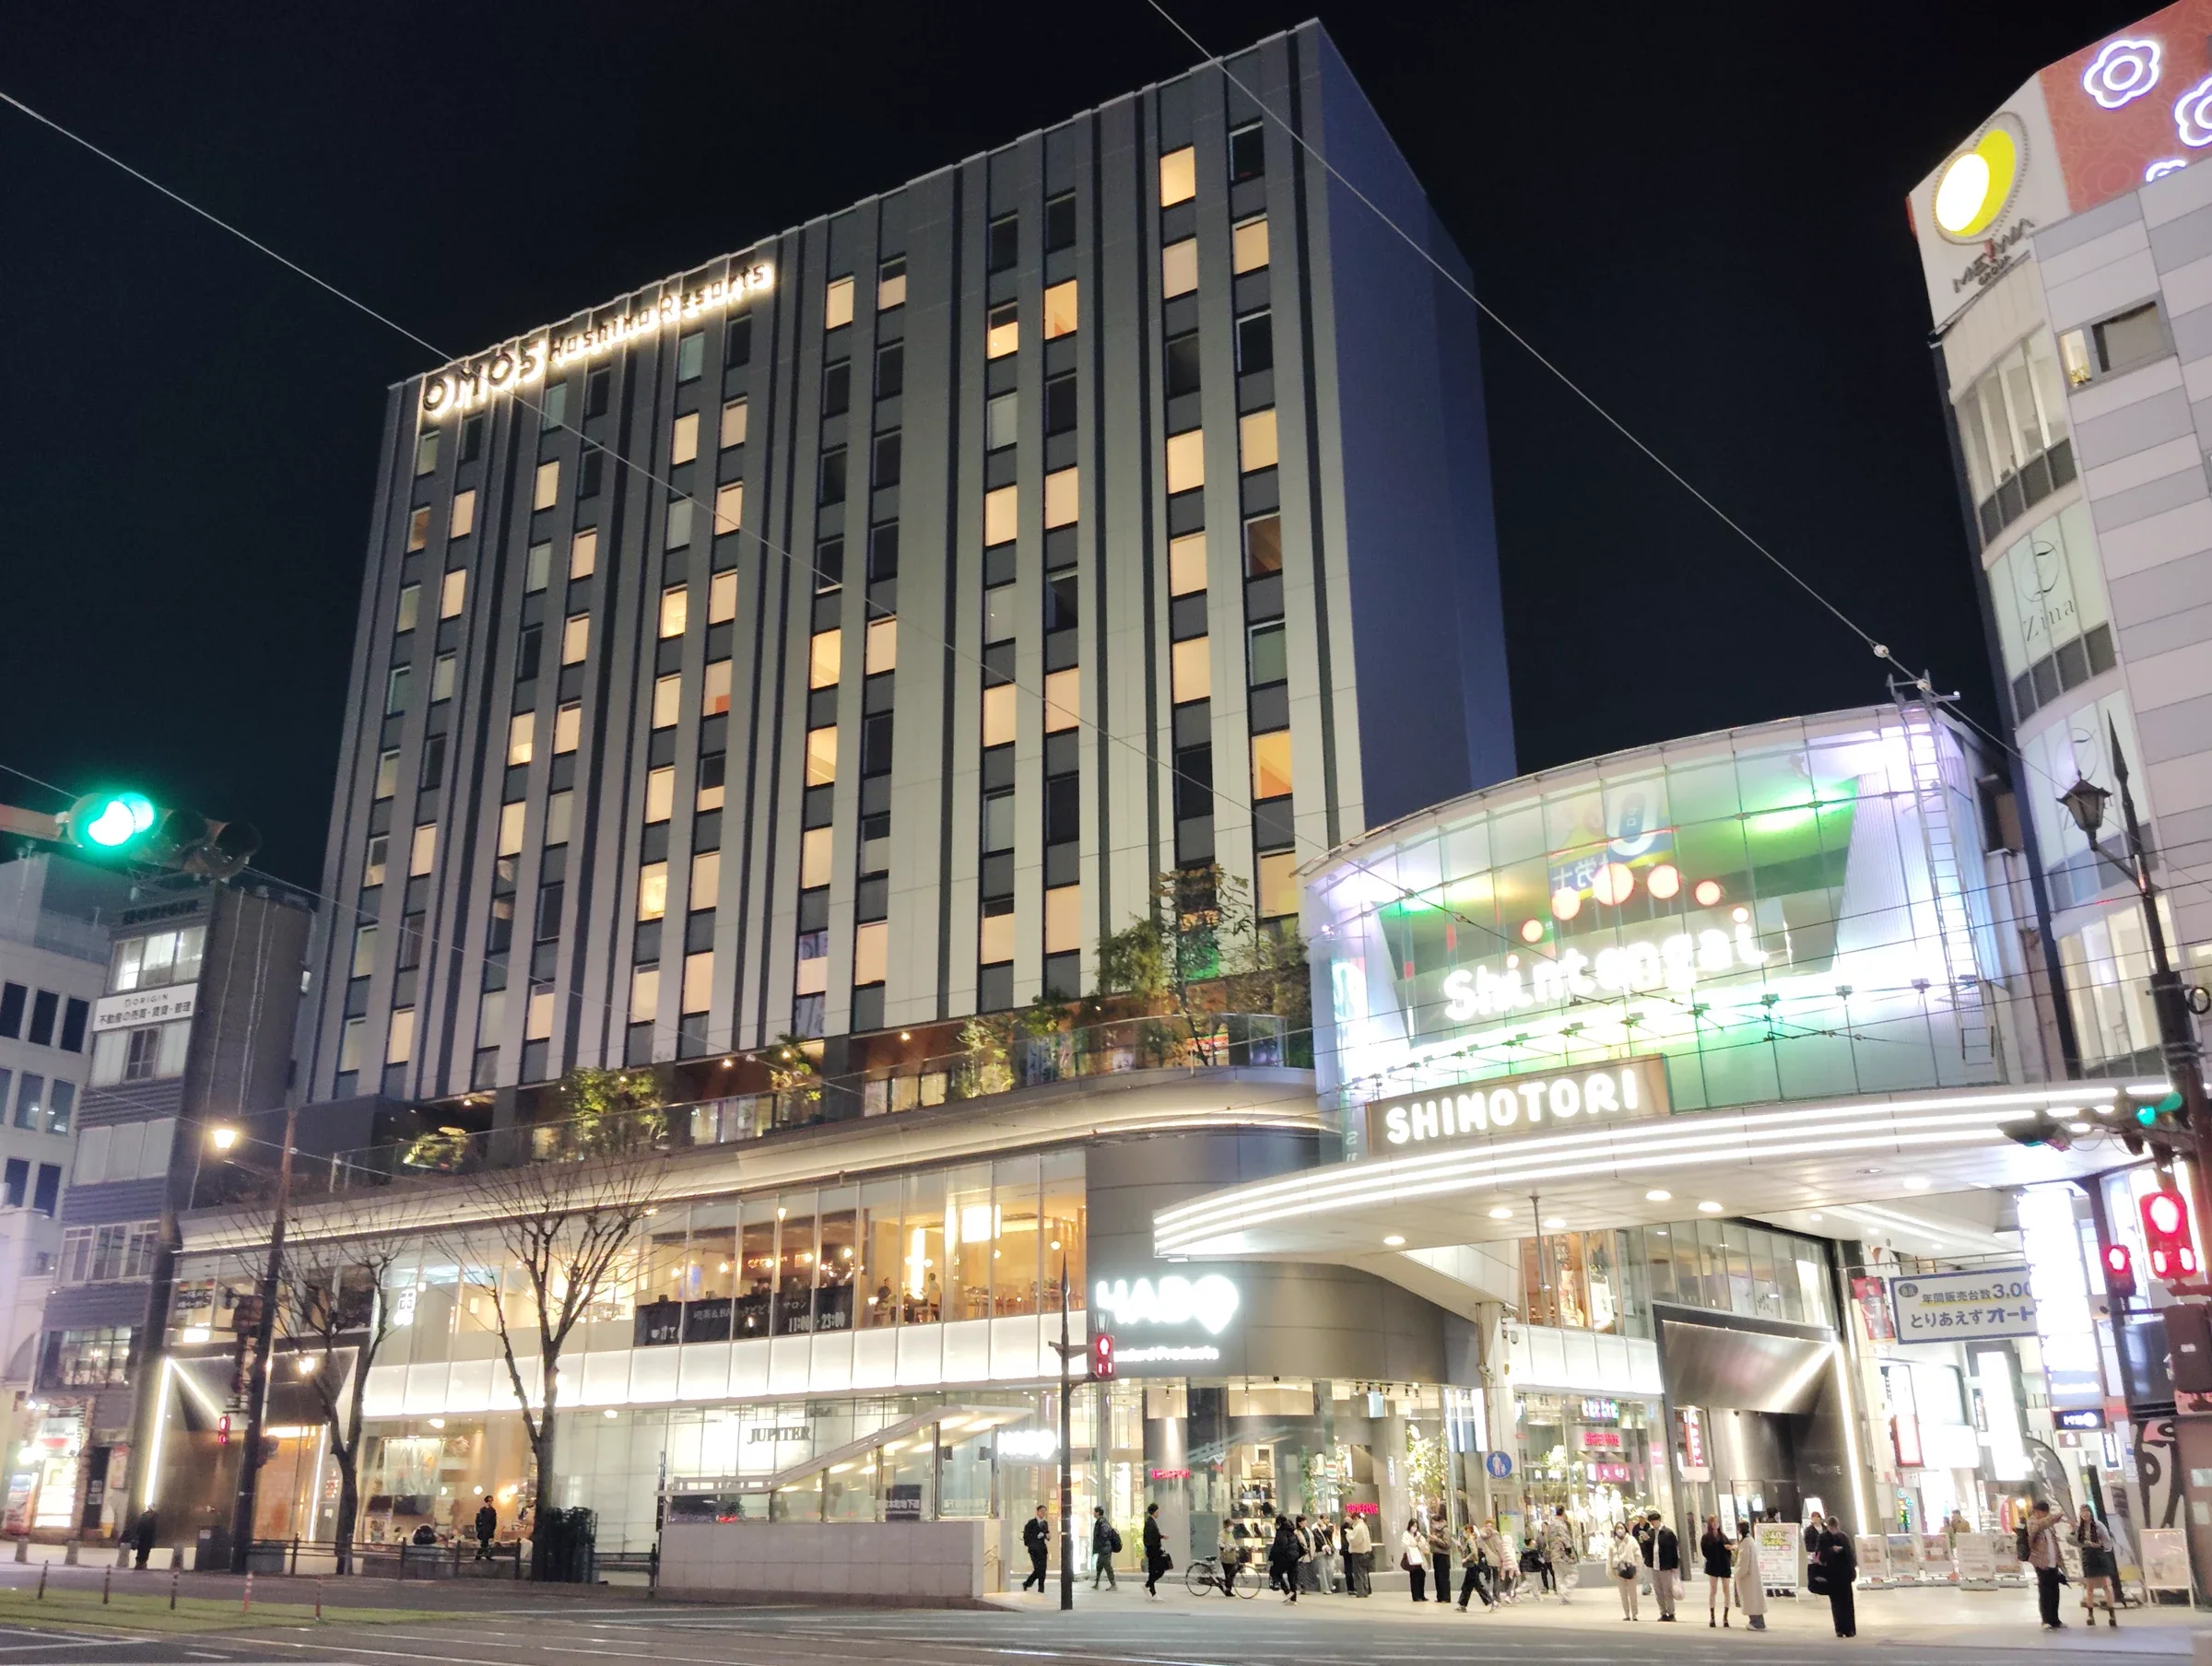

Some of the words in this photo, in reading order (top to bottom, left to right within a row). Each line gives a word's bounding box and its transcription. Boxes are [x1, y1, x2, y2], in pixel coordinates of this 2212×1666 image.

[423, 340, 546, 414] OMO5
[548, 307, 658, 362] Hoshino
[659, 263, 771, 322] Resorts
[2023, 599, 2075, 642] Zina
[1442, 907, 1770, 1022] Shintengai
[132, 993, 169, 1006] ORIGIN
[1385, 1069, 1639, 1144] SHIMOTORI
[747, 1425, 812, 1445] JUPITER
